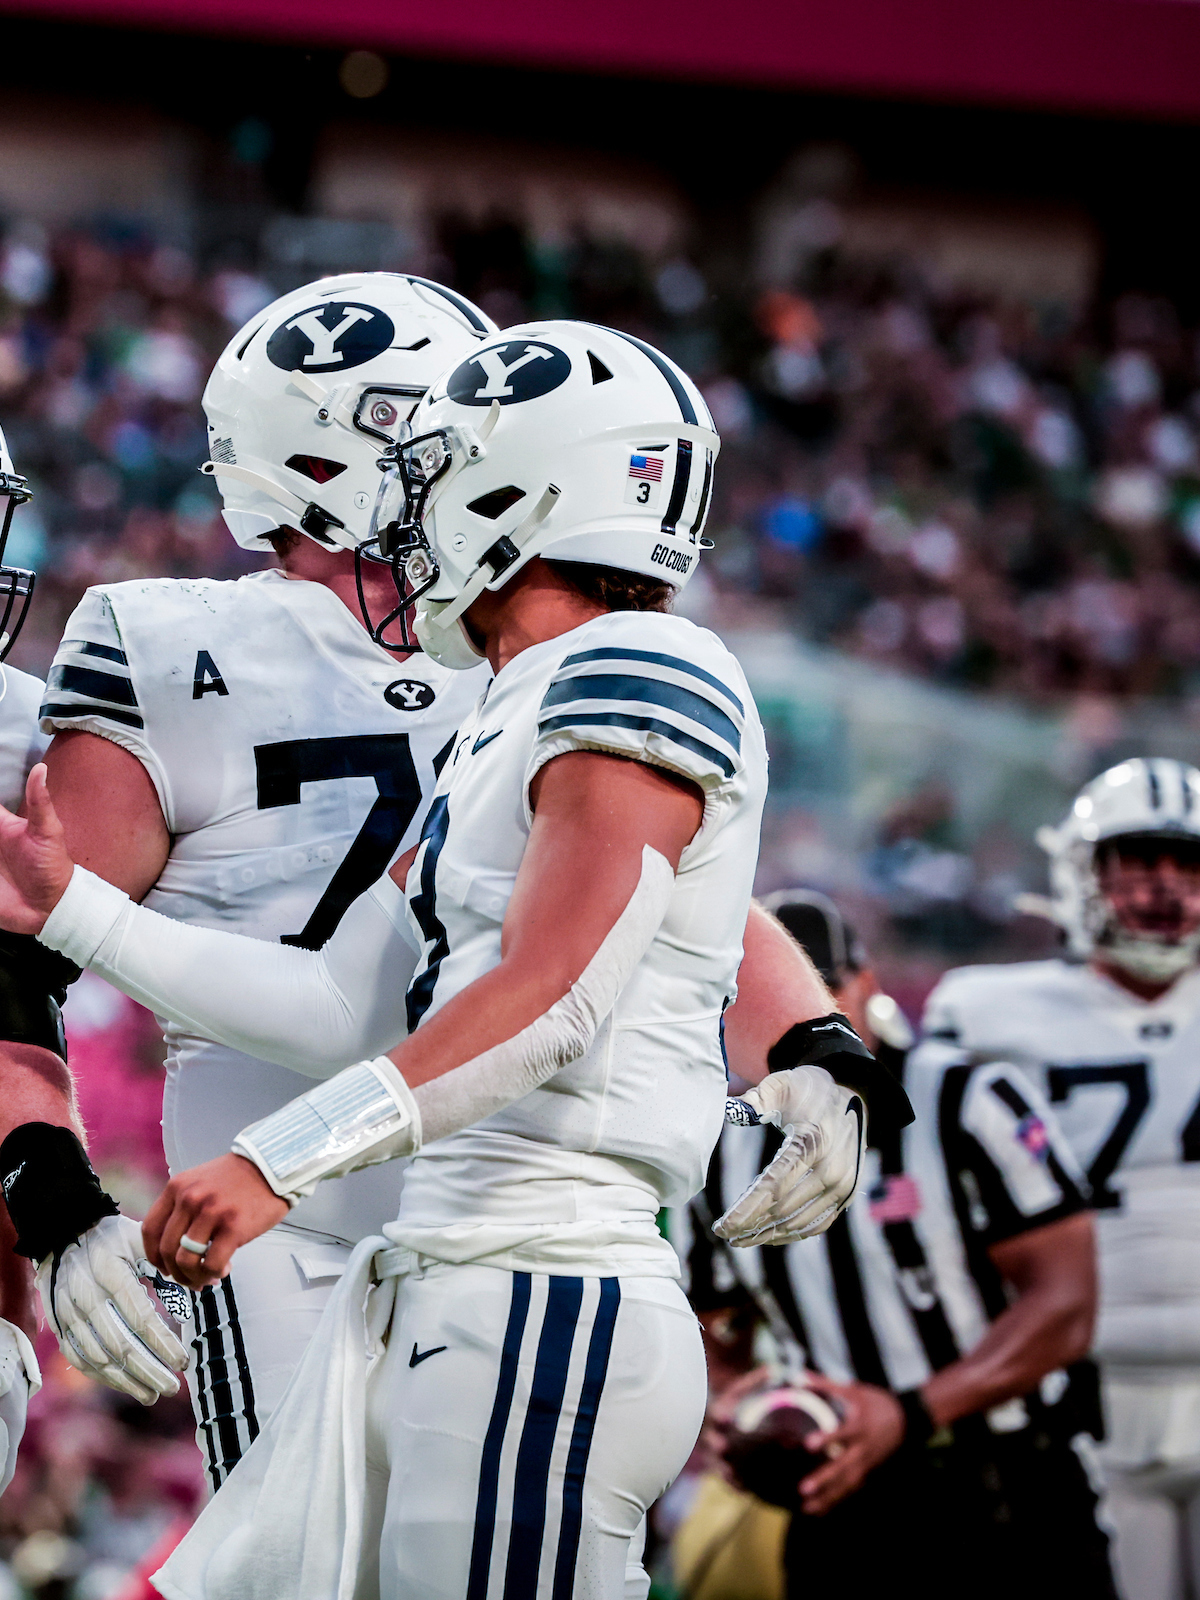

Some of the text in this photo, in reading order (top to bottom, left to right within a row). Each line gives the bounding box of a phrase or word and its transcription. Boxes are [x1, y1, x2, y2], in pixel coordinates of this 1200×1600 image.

[285, 307, 375, 365] Y
[468, 345, 555, 398] Y
[636, 482, 651, 504] 3
[651, 543, 669, 565] GO
[192, 650, 229, 699] A
[254, 733, 458, 953] 7
[1047, 1062, 1200, 1209] 7
